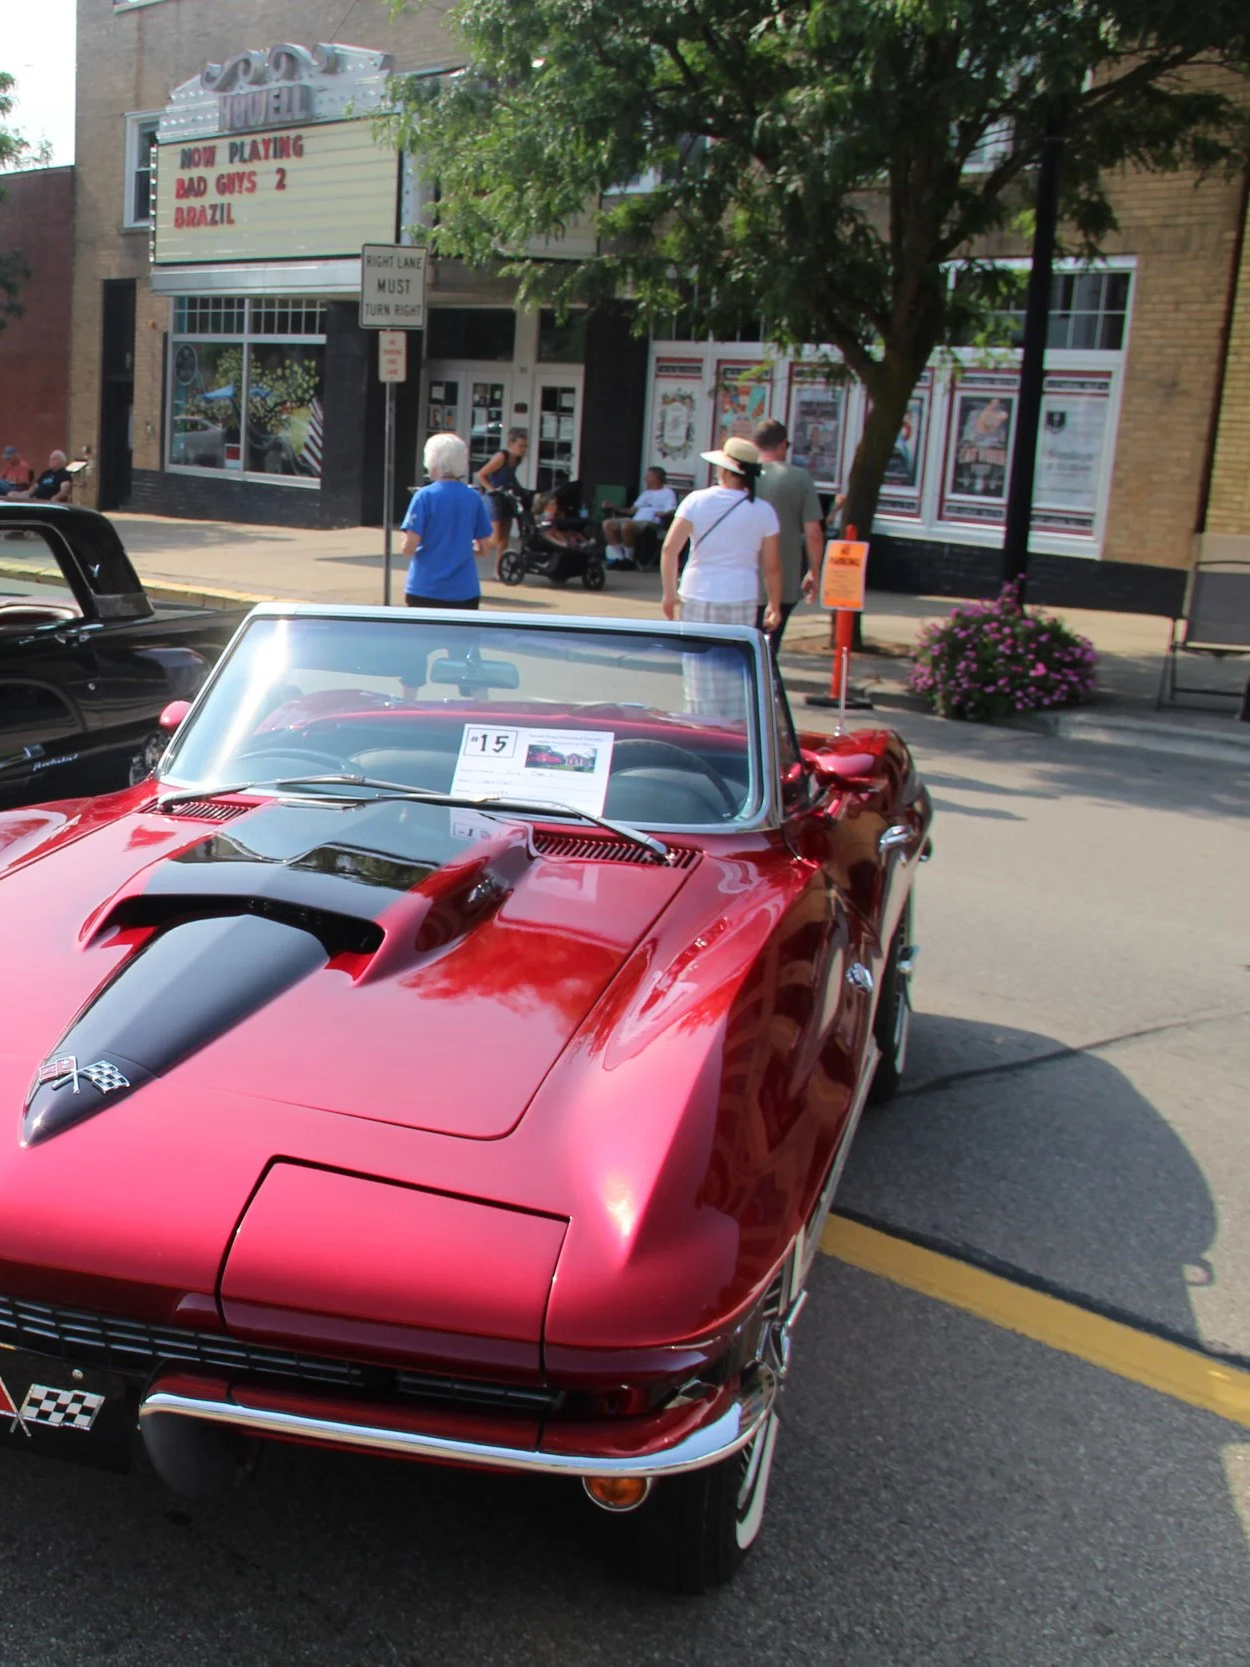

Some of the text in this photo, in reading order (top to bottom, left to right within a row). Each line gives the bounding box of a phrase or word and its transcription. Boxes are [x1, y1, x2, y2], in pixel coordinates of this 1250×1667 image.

[180, 135, 304, 170] NOW PLAYING
[175, 168, 286, 199] BAD GUYS 2
[174, 202, 235, 228] BRAZIL
[366, 255, 422, 269] RIGHT LANE
[377, 279, 411, 294] MUST
[365, 303, 421, 317] TURN RIGHT
